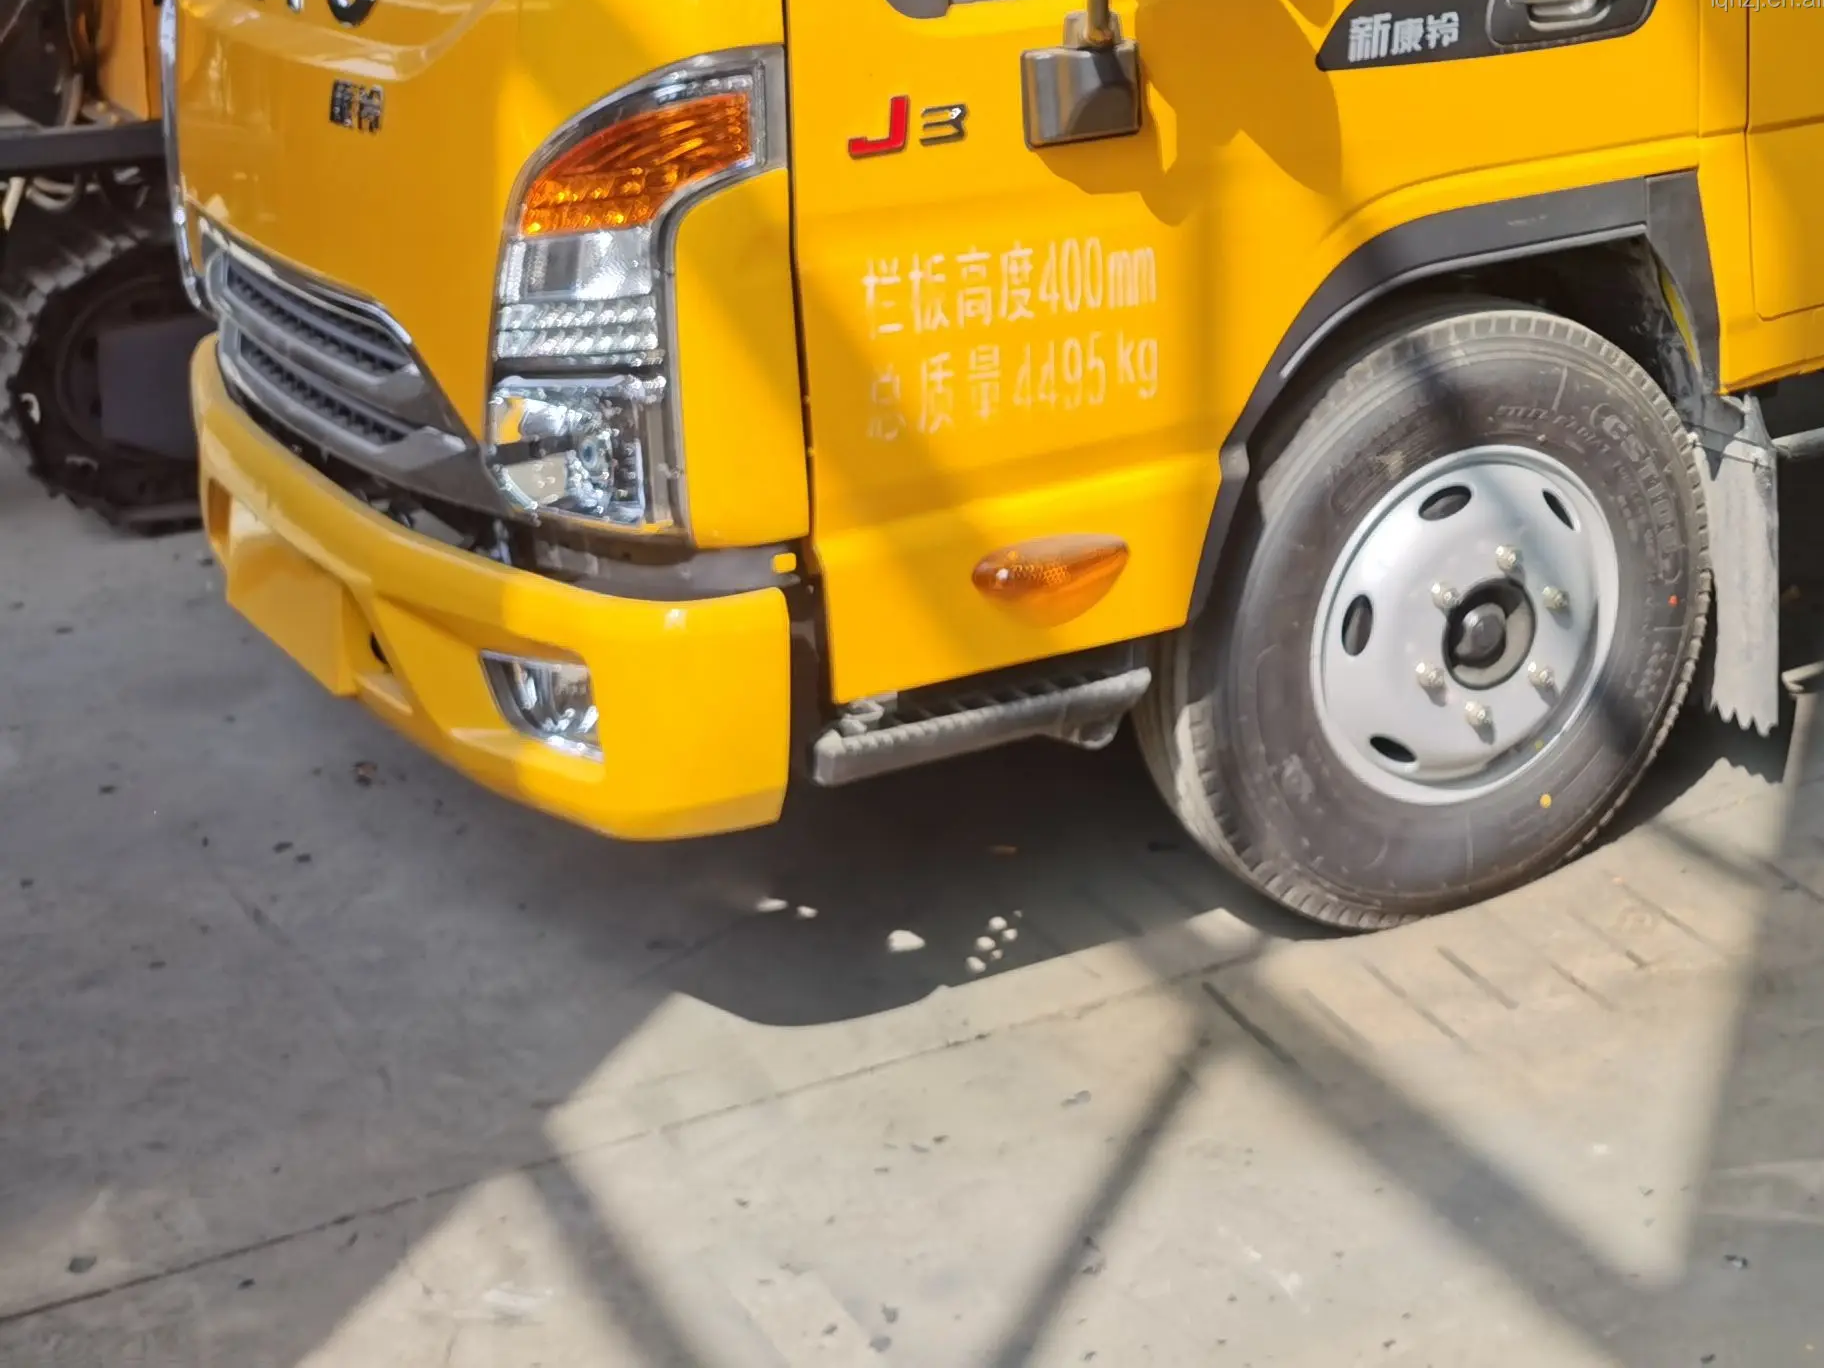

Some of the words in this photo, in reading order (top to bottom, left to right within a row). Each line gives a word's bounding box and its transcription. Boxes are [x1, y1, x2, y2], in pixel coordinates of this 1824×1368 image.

[1347, 12, 1459, 63] 新康铃
[847, 94, 968, 160] J3
[1117, 331, 1159, 400] kg
